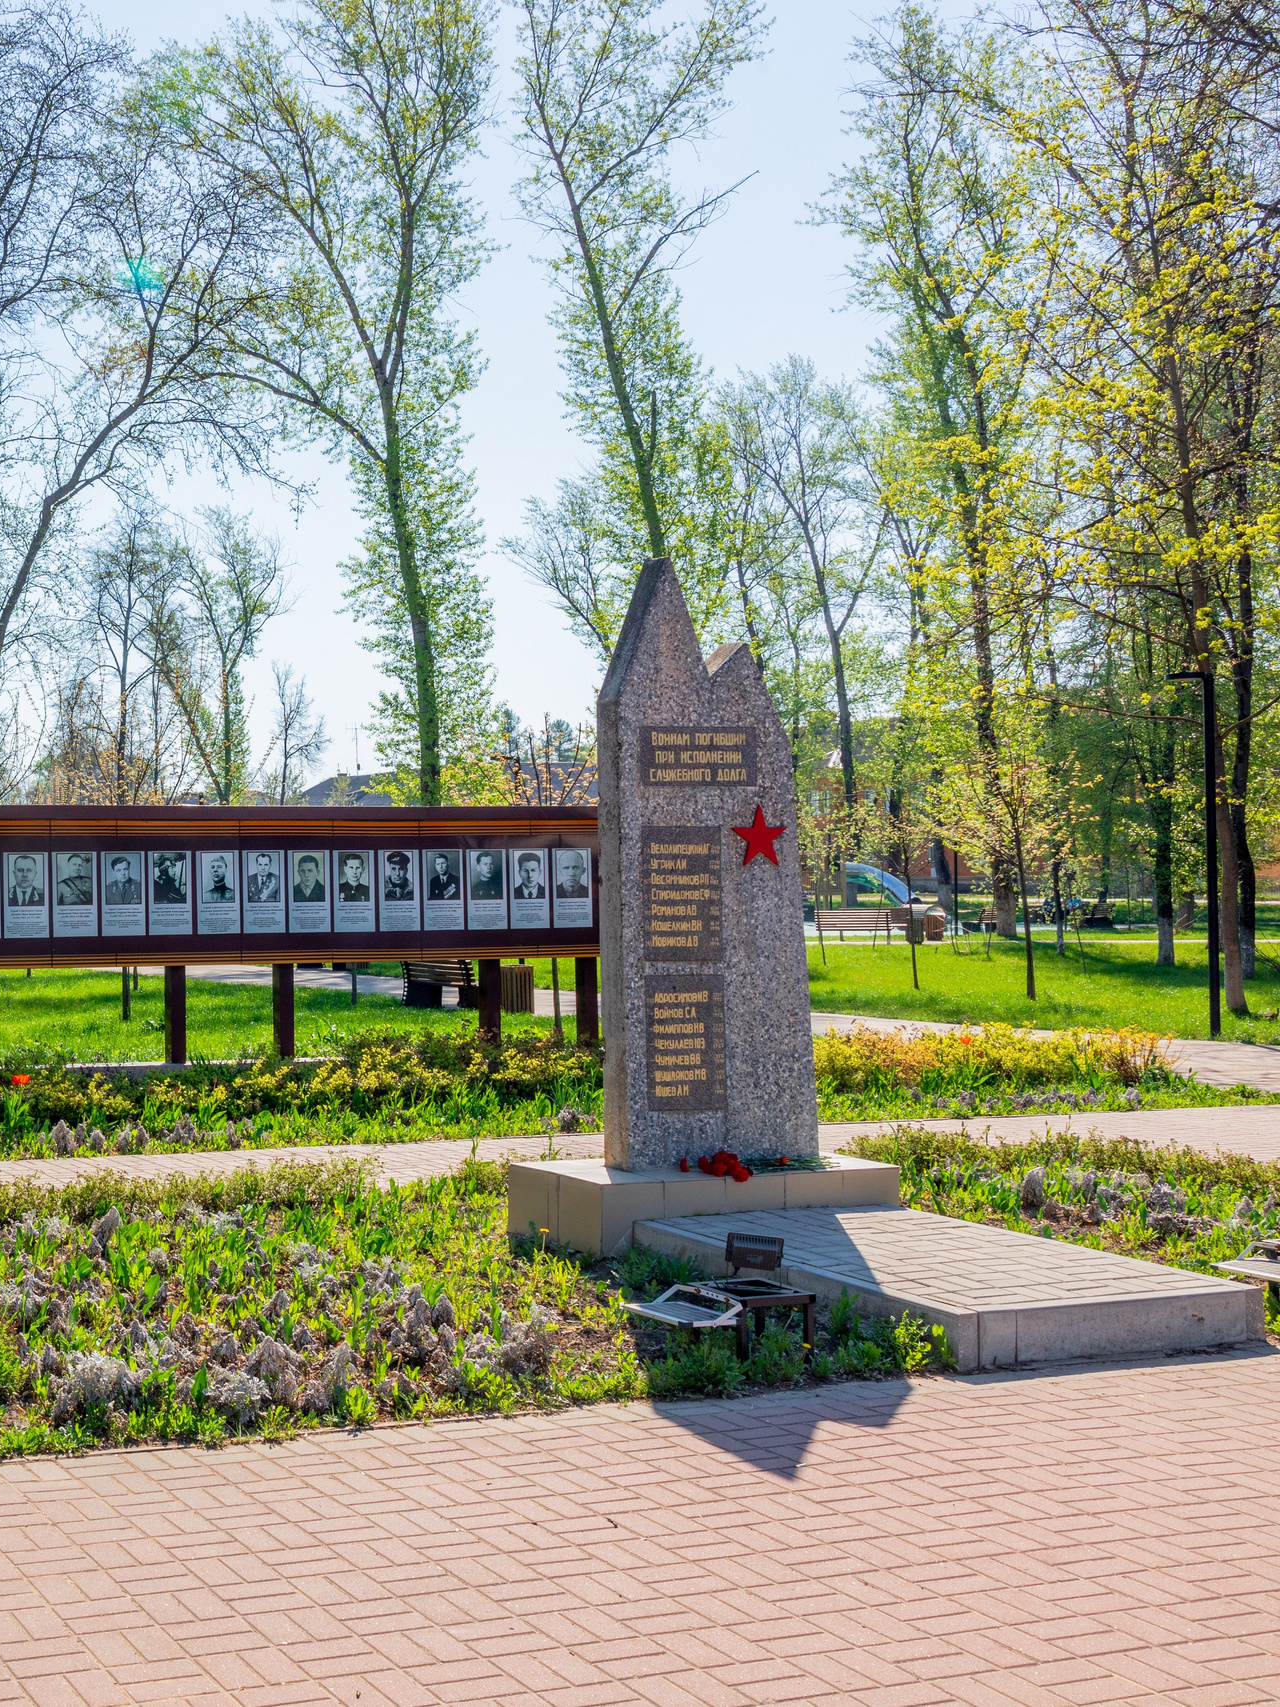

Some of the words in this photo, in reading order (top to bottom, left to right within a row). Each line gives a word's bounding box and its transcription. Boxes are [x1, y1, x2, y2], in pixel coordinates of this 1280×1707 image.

[681, 751, 742, 763] ИСПОЛНЕНИИ
[650, 768, 711, 782] СЛУЖЕБНОГО
[716, 768, 747, 781] ДОЛГА
